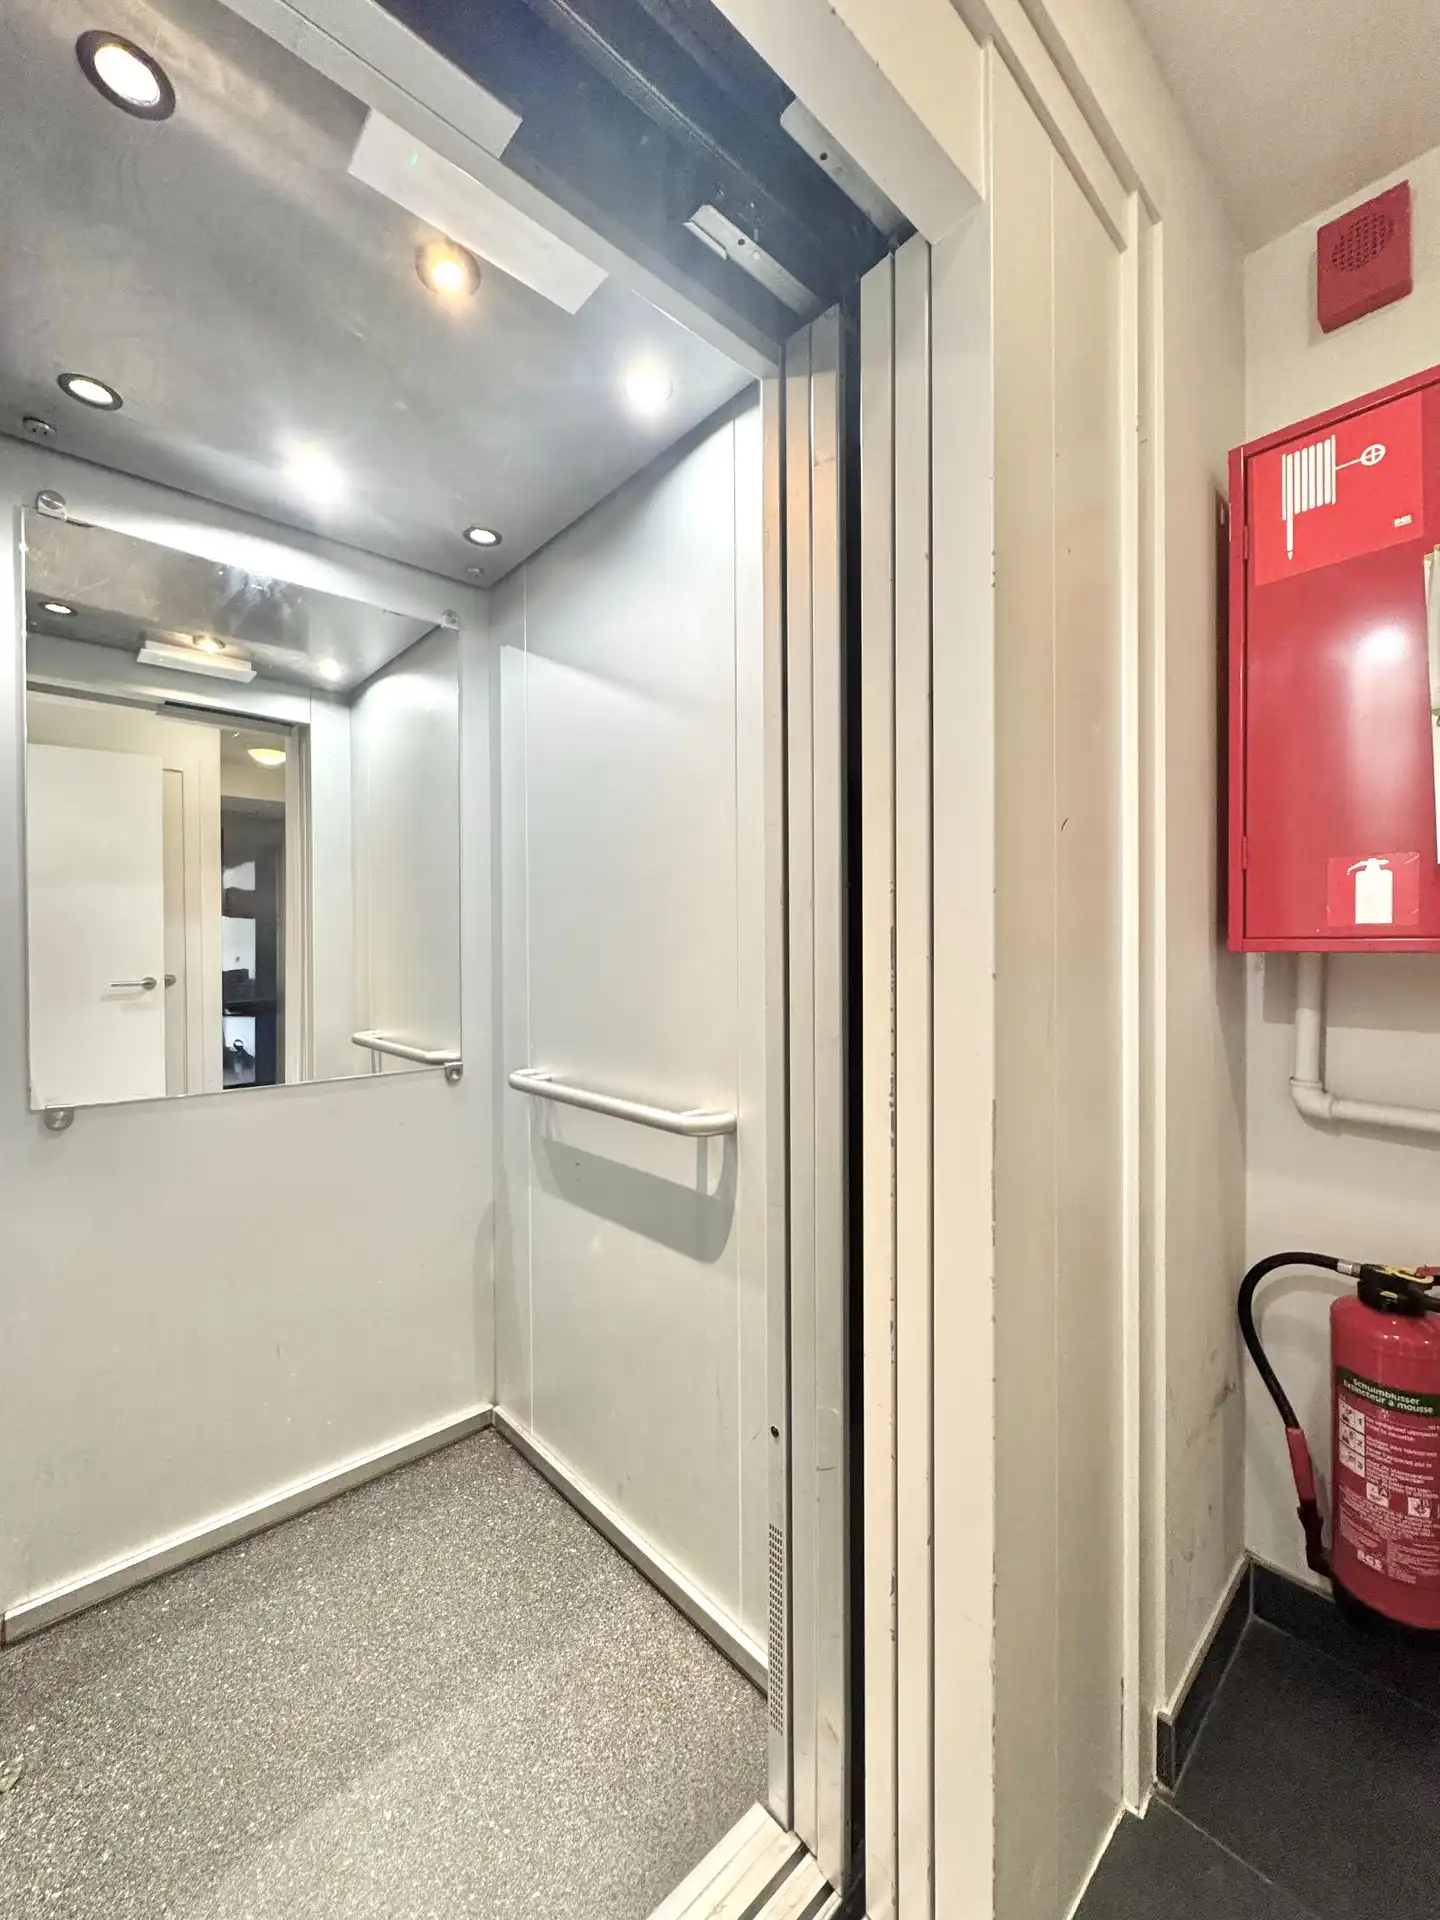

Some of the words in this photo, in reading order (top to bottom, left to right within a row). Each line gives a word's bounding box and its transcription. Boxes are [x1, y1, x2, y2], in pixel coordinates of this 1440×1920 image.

[1343, 1379, 1386, 1404] Extincteur
[1397, 1402, 1433, 1413] mousse
[1353, 1378, 1420, 1405] Schuimblusser
